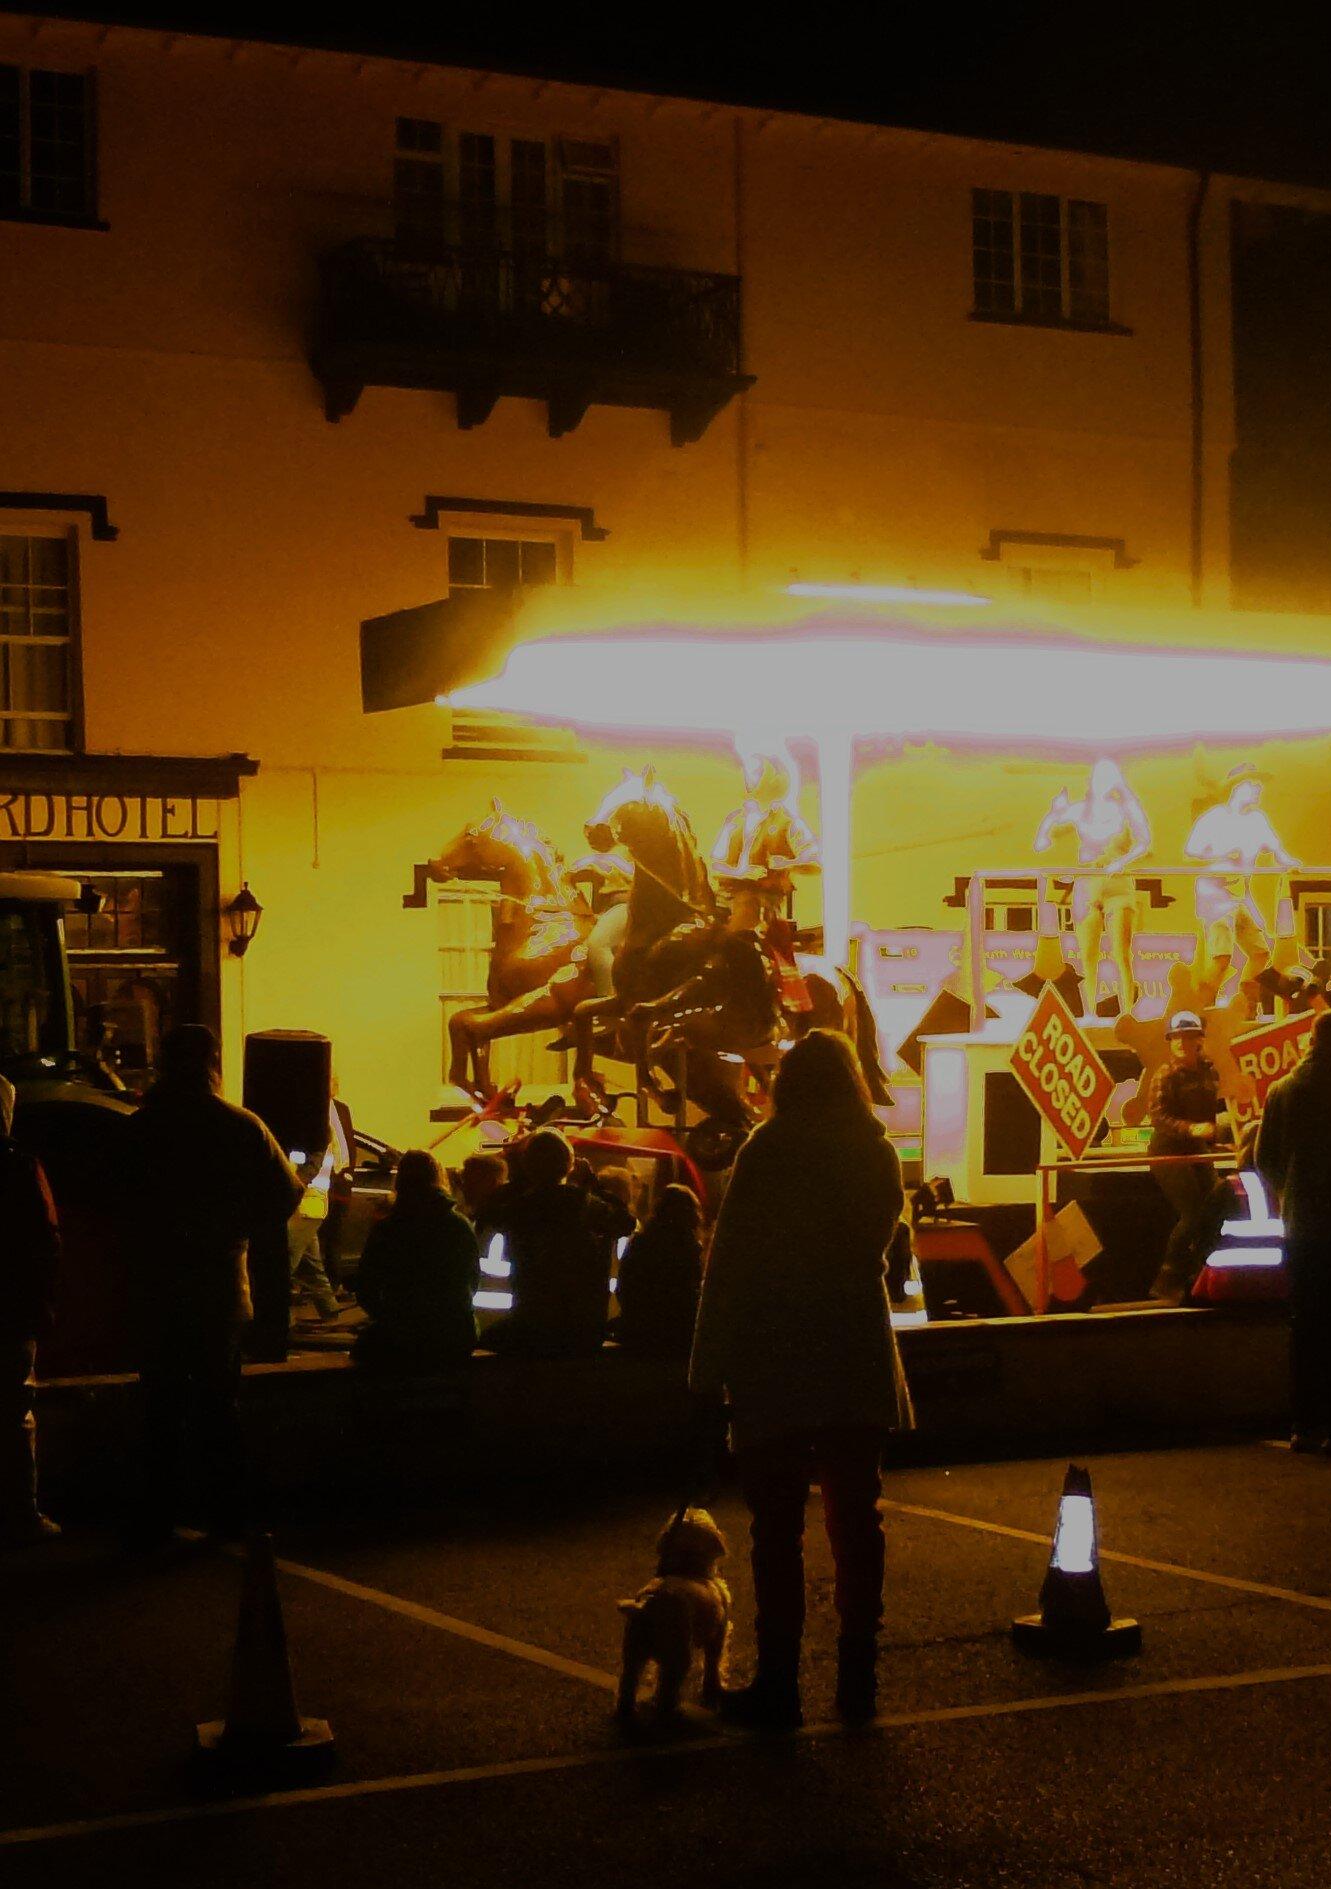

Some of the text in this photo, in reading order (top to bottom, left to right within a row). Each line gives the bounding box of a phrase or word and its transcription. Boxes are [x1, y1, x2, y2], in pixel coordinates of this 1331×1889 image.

[64, 793, 219, 839] HOTEL
[1018, 1030, 1091, 1139] CLOSED
[1042, 1013, 1097, 1098] ROAD
